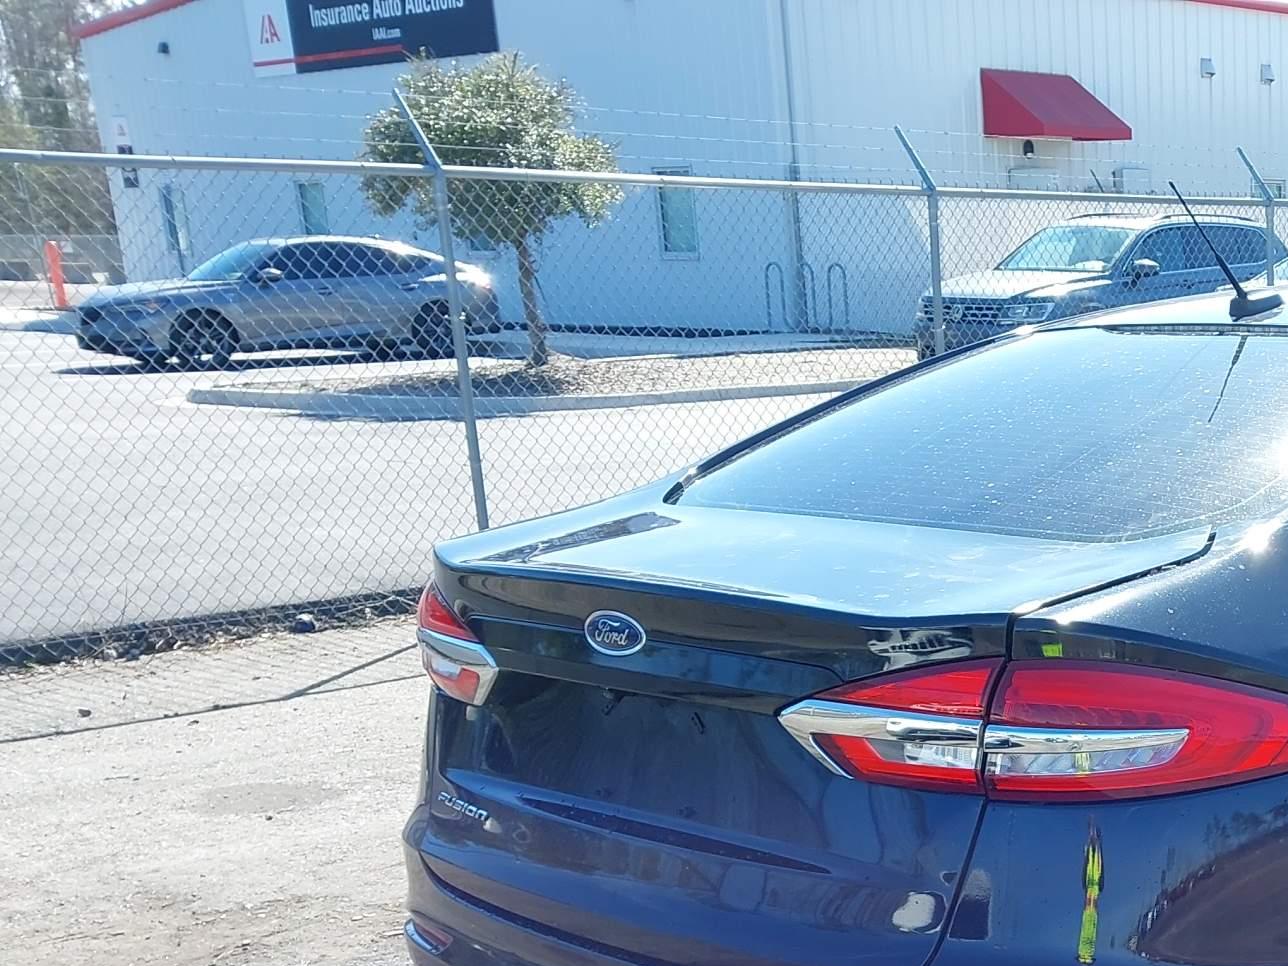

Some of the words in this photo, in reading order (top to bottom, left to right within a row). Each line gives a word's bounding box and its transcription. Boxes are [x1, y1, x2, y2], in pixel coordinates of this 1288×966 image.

[308, 3, 370, 28] Insurance
[372, 0, 402, 19] Auto
[595, 618, 630, 646] Ford
